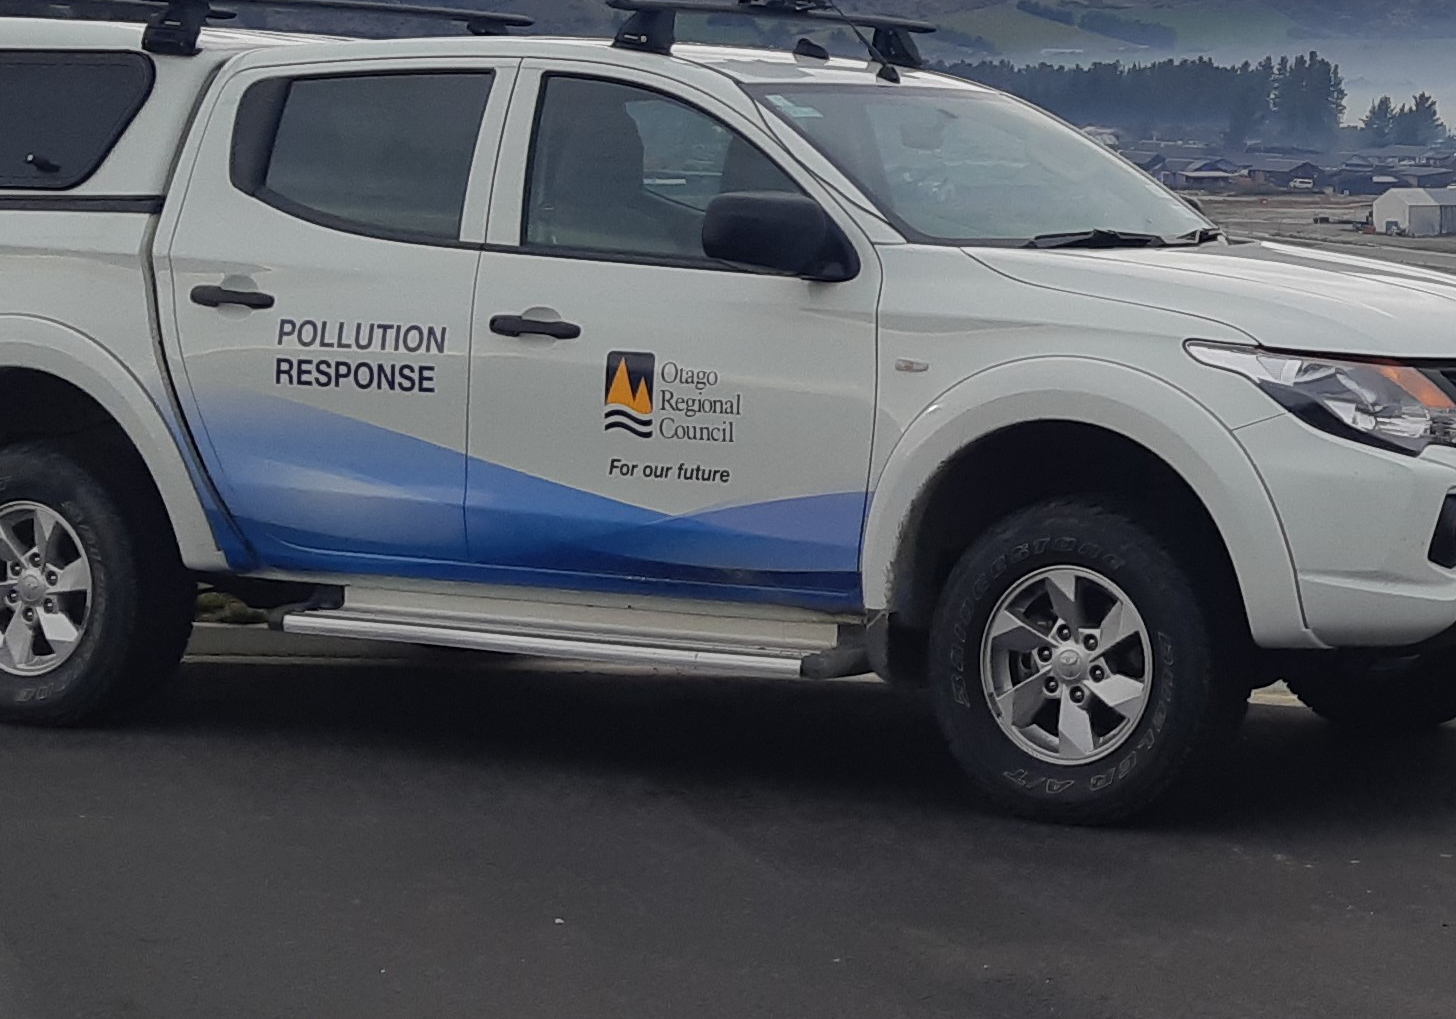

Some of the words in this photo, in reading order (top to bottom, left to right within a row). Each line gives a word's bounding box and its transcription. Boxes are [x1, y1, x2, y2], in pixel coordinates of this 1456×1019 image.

[277, 318, 447, 354] POLLUTION
[275, 357, 436, 393] RESPONSE
[660, 361, 718, 390] Otago
[659, 389, 741, 417] Regional
[659, 417, 735, 443] Council
[608, 458, 638, 477] For
[642, 463, 672, 479] our
[677, 463, 730, 483] future
